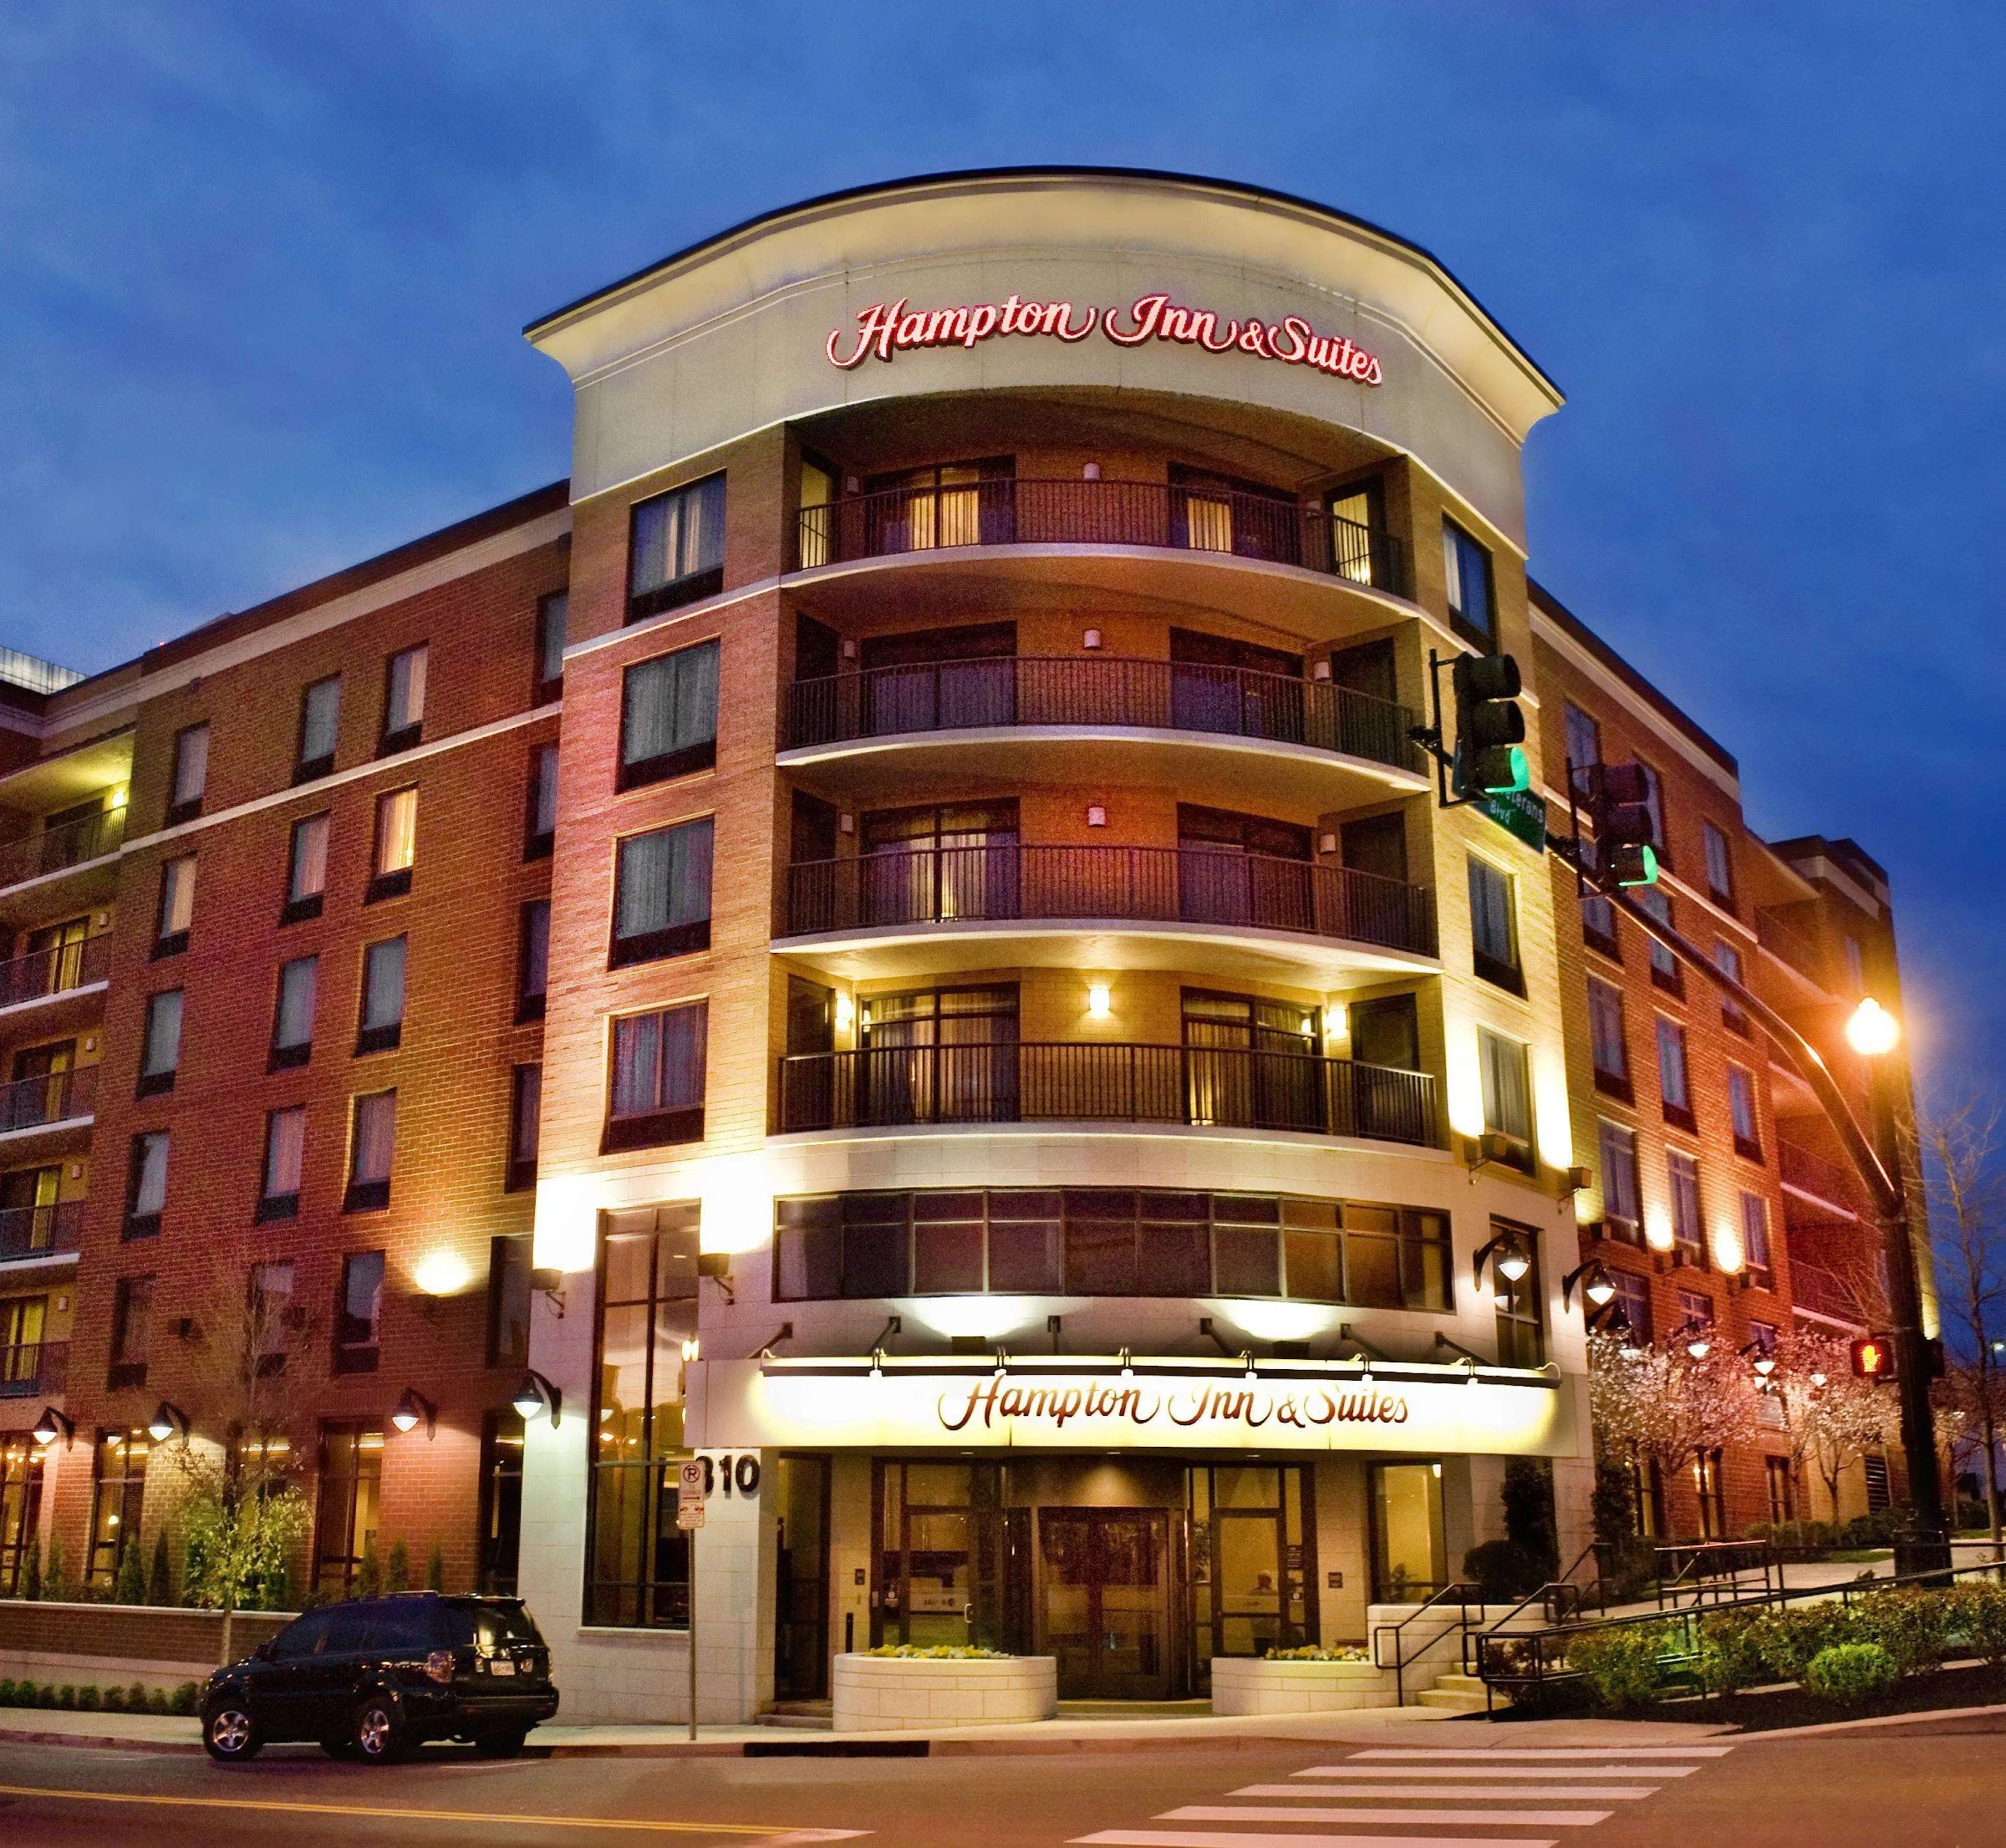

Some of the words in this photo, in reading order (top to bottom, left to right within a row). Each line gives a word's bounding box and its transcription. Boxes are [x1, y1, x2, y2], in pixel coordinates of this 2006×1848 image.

[826, 293, 1098, 370] Hampton
[1102, 293, 1238, 354] Inn
[1237, 317, 1272, 359] &
[1266, 313, 1382, 388] Suites
[1504, 792, 1544, 824] eterans
[938, 1374, 1160, 1430] Hampton
[1168, 1383, 1273, 1427] Inn
[1277, 1393, 1306, 1428] &
[1303, 1384, 1408, 1423] Suites
